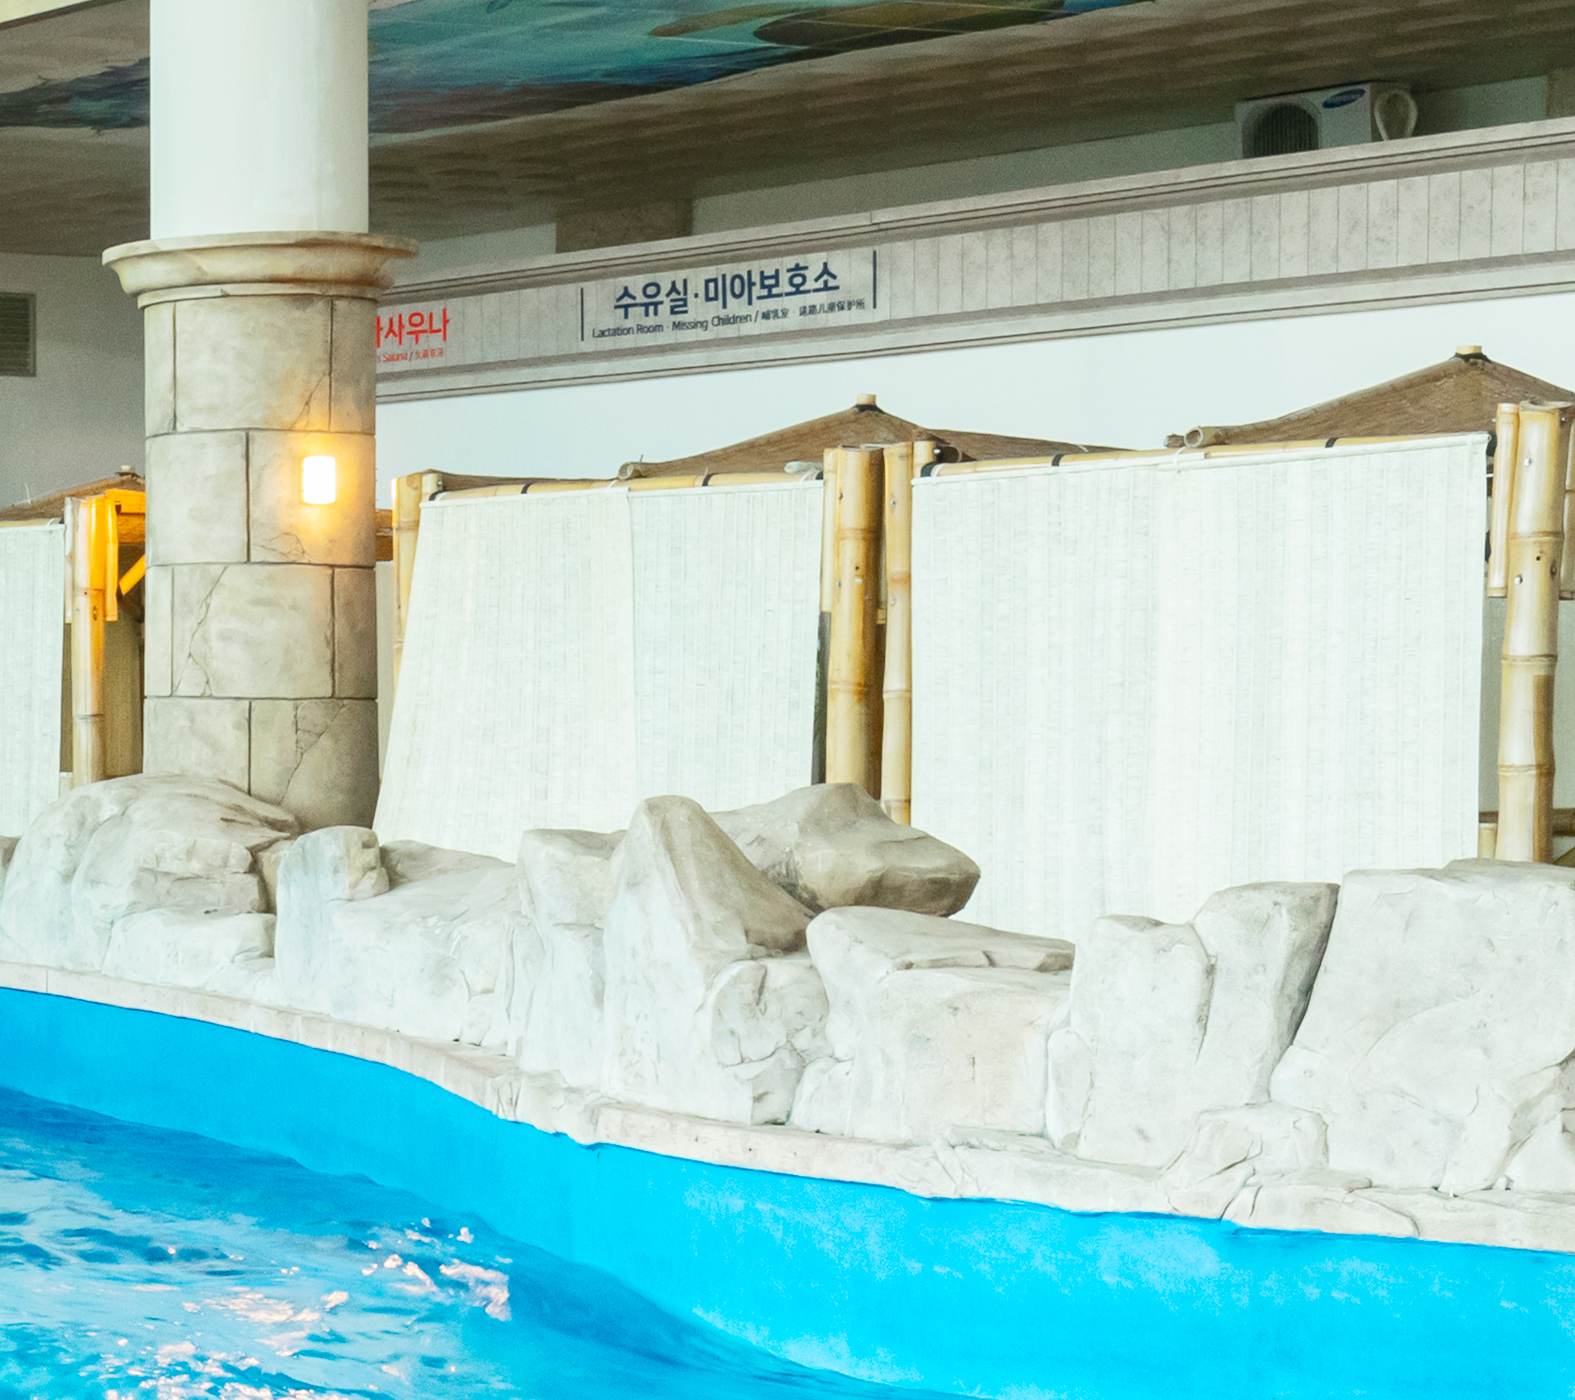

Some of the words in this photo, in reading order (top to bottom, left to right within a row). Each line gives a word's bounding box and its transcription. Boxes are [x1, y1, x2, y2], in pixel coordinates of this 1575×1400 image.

[592, 326, 634, 338] Lactation
[636, 323, 664, 335] Room
[672, 320, 708, 332] Missing
[711, 314, 752, 326] Children
